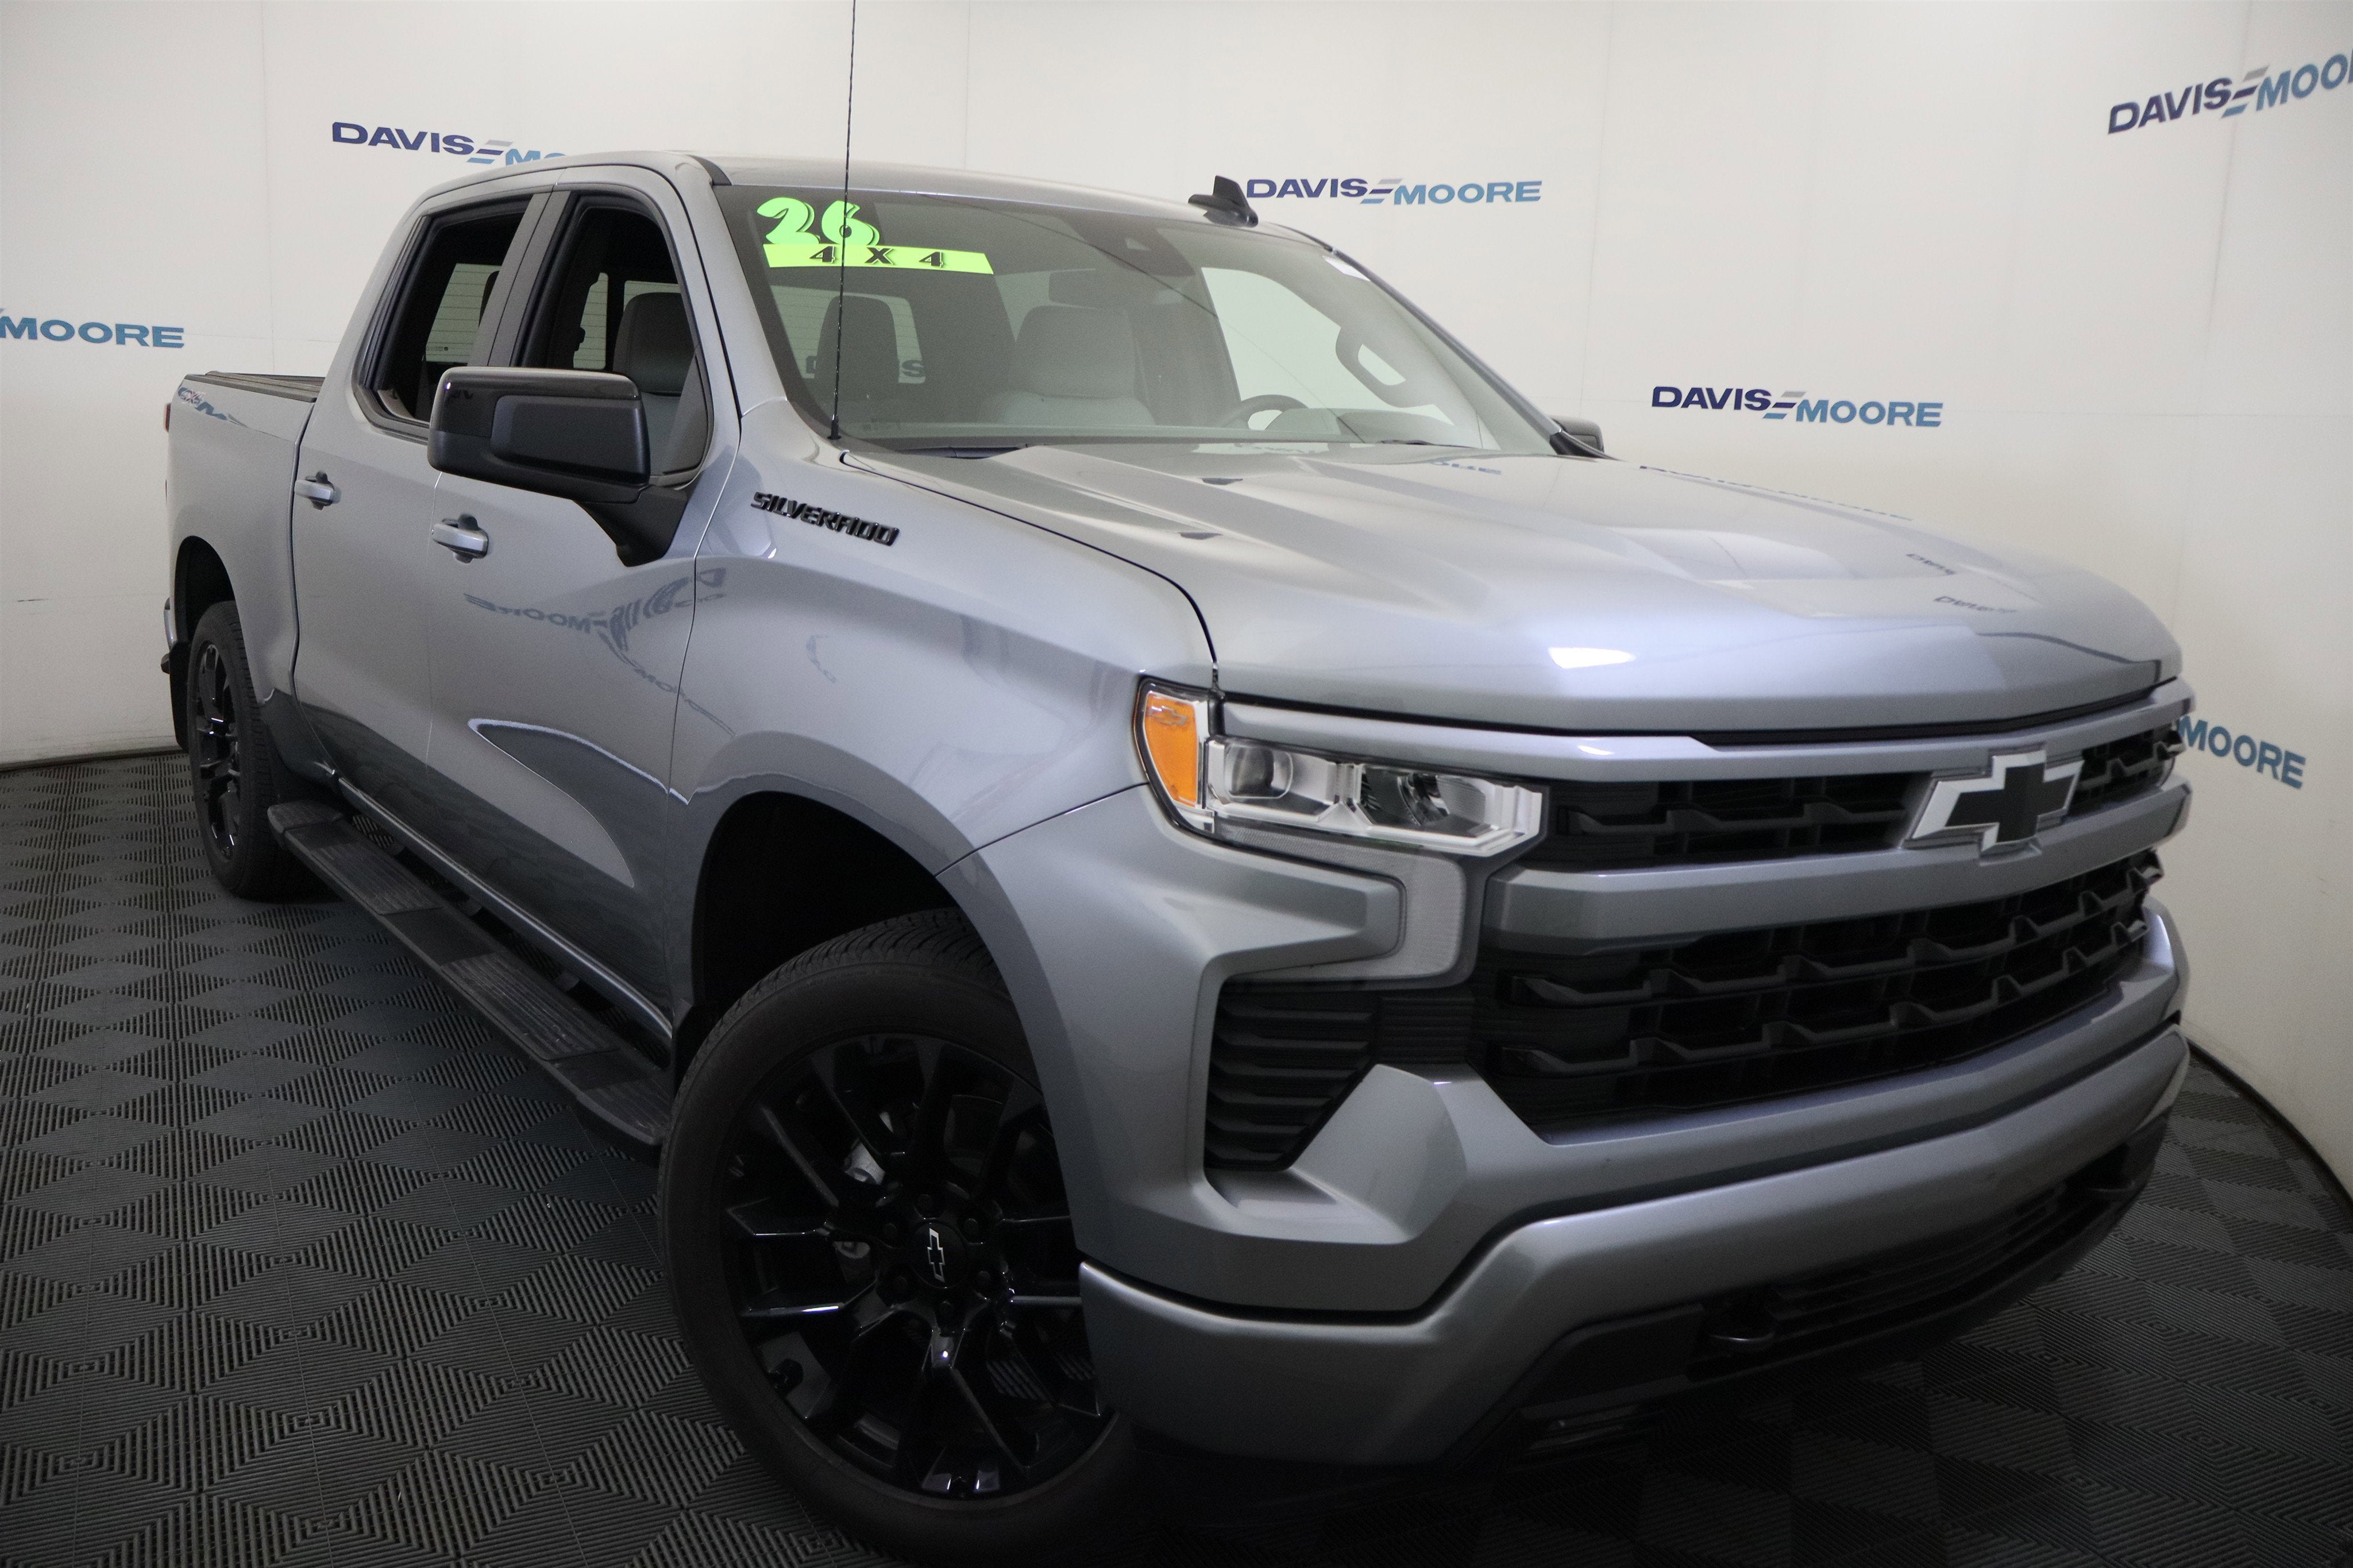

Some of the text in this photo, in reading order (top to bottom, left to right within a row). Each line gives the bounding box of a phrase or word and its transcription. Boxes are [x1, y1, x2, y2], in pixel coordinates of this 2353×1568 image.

[2108, 49, 2353, 134] DAVIS MOO
[332, 122, 475, 155] DAVIS
[1247, 178, 1542, 205] DAVIS MOORE
[757, 196, 880, 246] 26
[0, 316, 185, 348] MOORE
[1652, 386, 1943, 427] DAVIS MOORE
[750, 492, 900, 546] SILVERADO
[2177, 716, 2306, 789] MOORE
